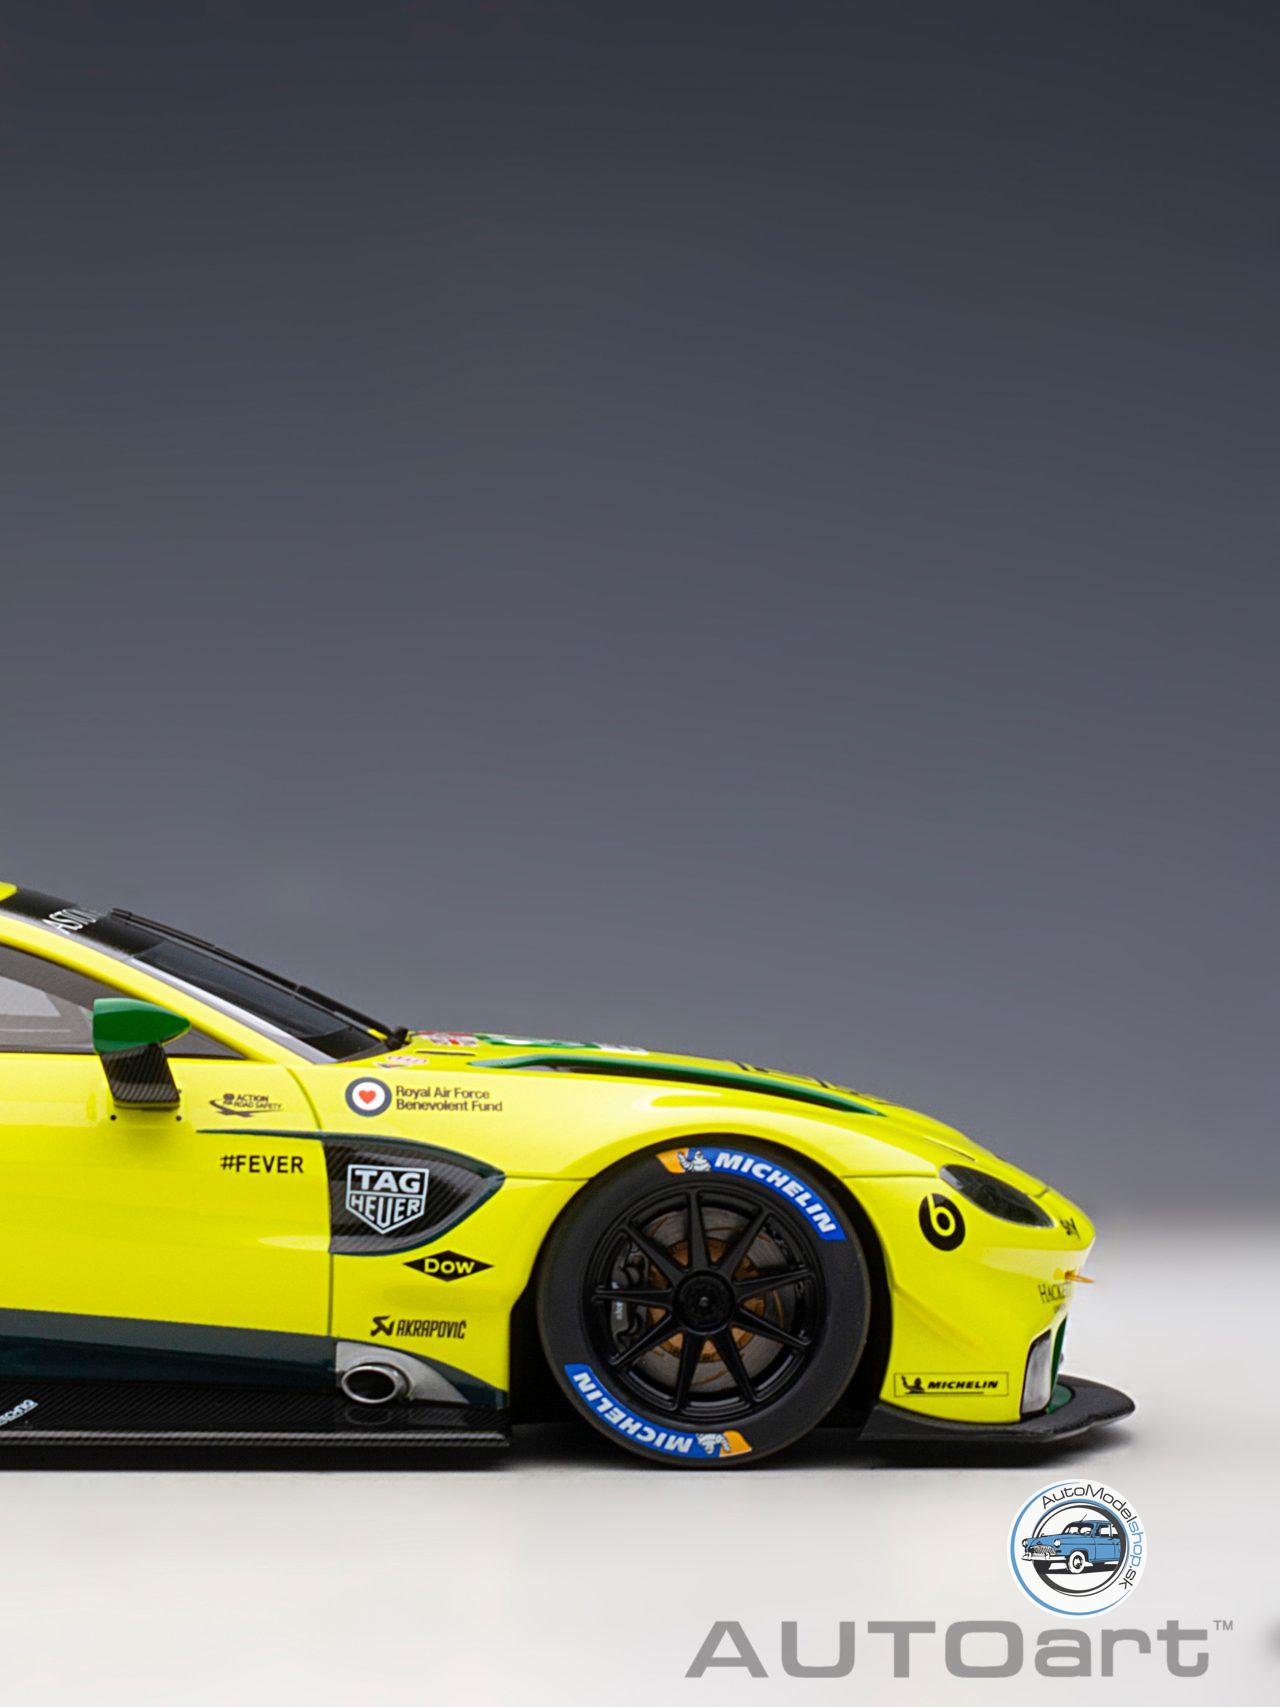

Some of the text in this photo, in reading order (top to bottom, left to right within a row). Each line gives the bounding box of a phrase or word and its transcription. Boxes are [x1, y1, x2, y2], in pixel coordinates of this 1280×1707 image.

[395, 1085, 490, 1100] Royal Air Force
[396, 1099, 503, 1112] Benevolent Fund
[220, 1154, 304, 1174] #FEVER
[354, 1169, 421, 1194] TAG
[714, 1152, 837, 1233] MICHELIN
[350, 1195, 421, 1229] HEUER
[928, 1381, 999, 1389] MICHELIN
[573, 1372, 693, 1453] MICHELIN
